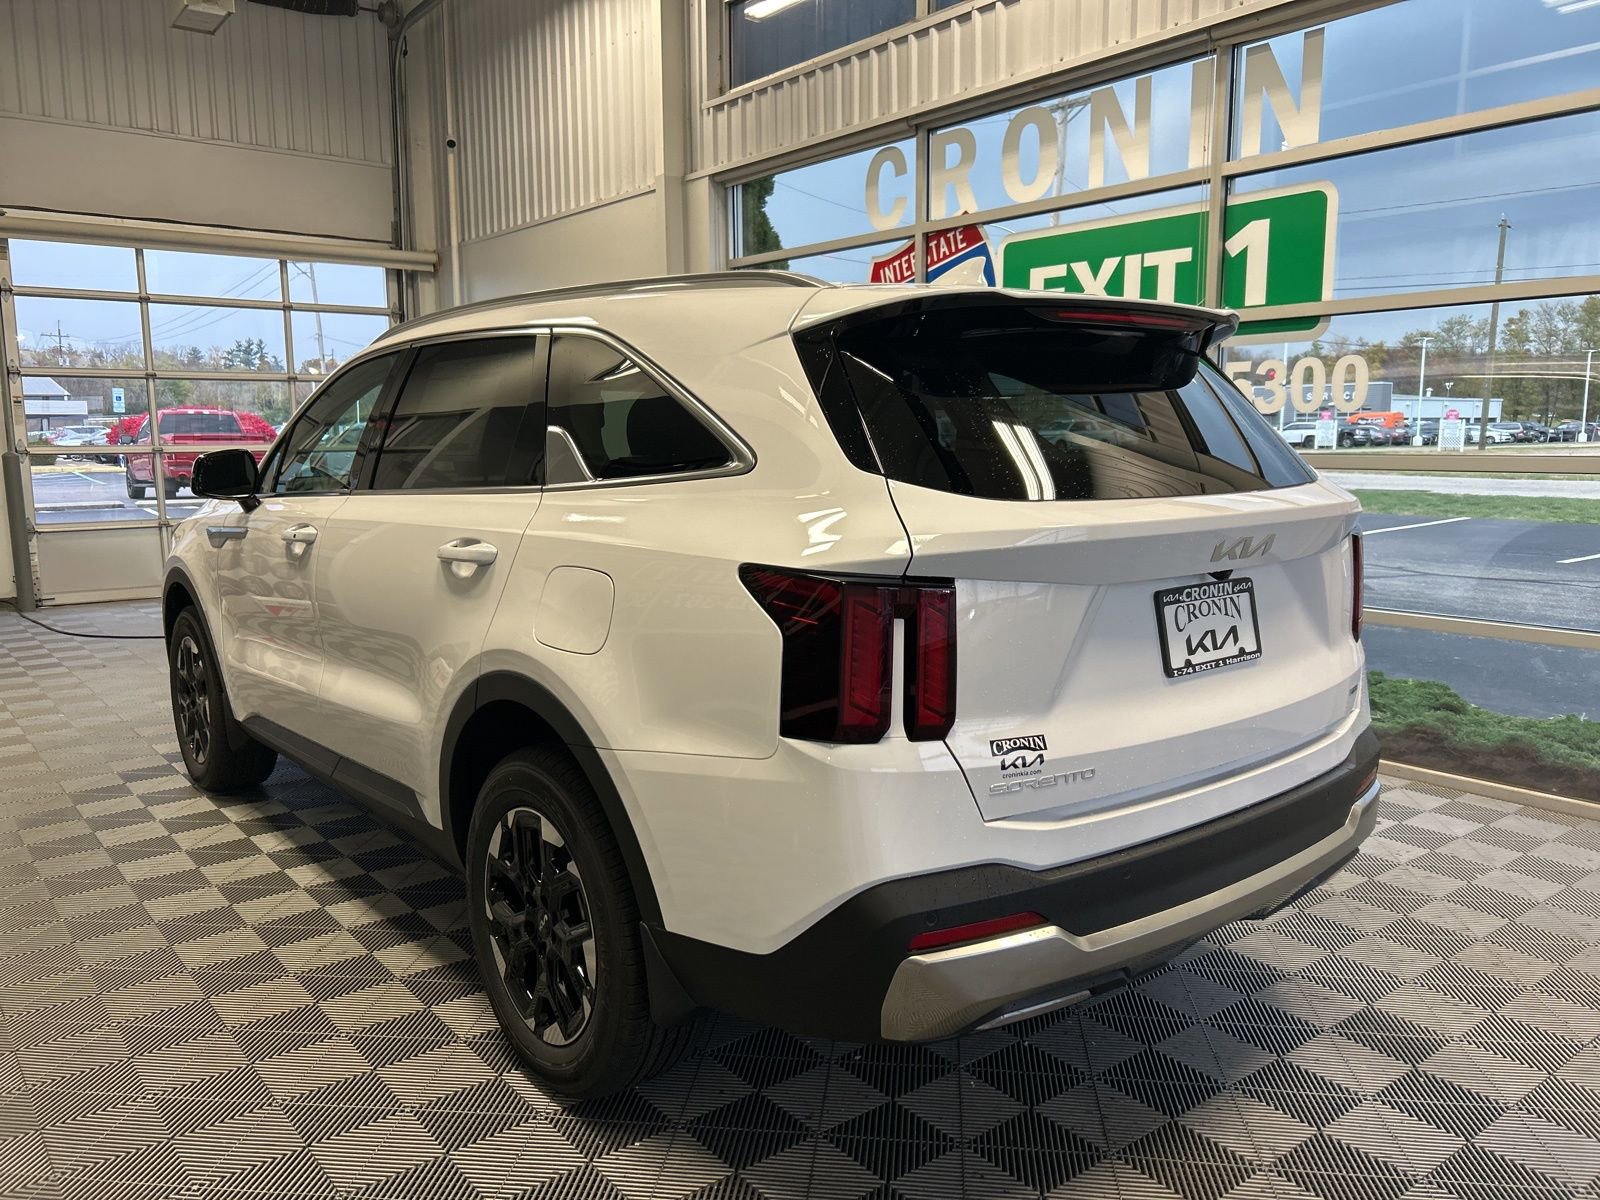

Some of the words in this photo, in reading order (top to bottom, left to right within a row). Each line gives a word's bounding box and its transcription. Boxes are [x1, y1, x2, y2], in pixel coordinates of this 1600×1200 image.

[865, 27, 1325, 231] CRONIN
[1225, 219, 1270, 307] 1
[1210, 533, 1276, 562] KIA
[1183, 582, 1233, 601] CRONIN
[1174, 595, 1242, 632] CRONIN
[1185, 624, 1239, 656] KIA
[1172, 667, 1194, 677] I-74
[1195, 661, 1217, 672] EXIT
[1226, 652, 1261, 664] Harrison
[992, 736, 1045, 756] CRONIN
[1000, 753, 1045, 771] KIA
[1002, 770, 1042, 779] croninkia.com
[989, 767, 1096, 795] SORENTO
